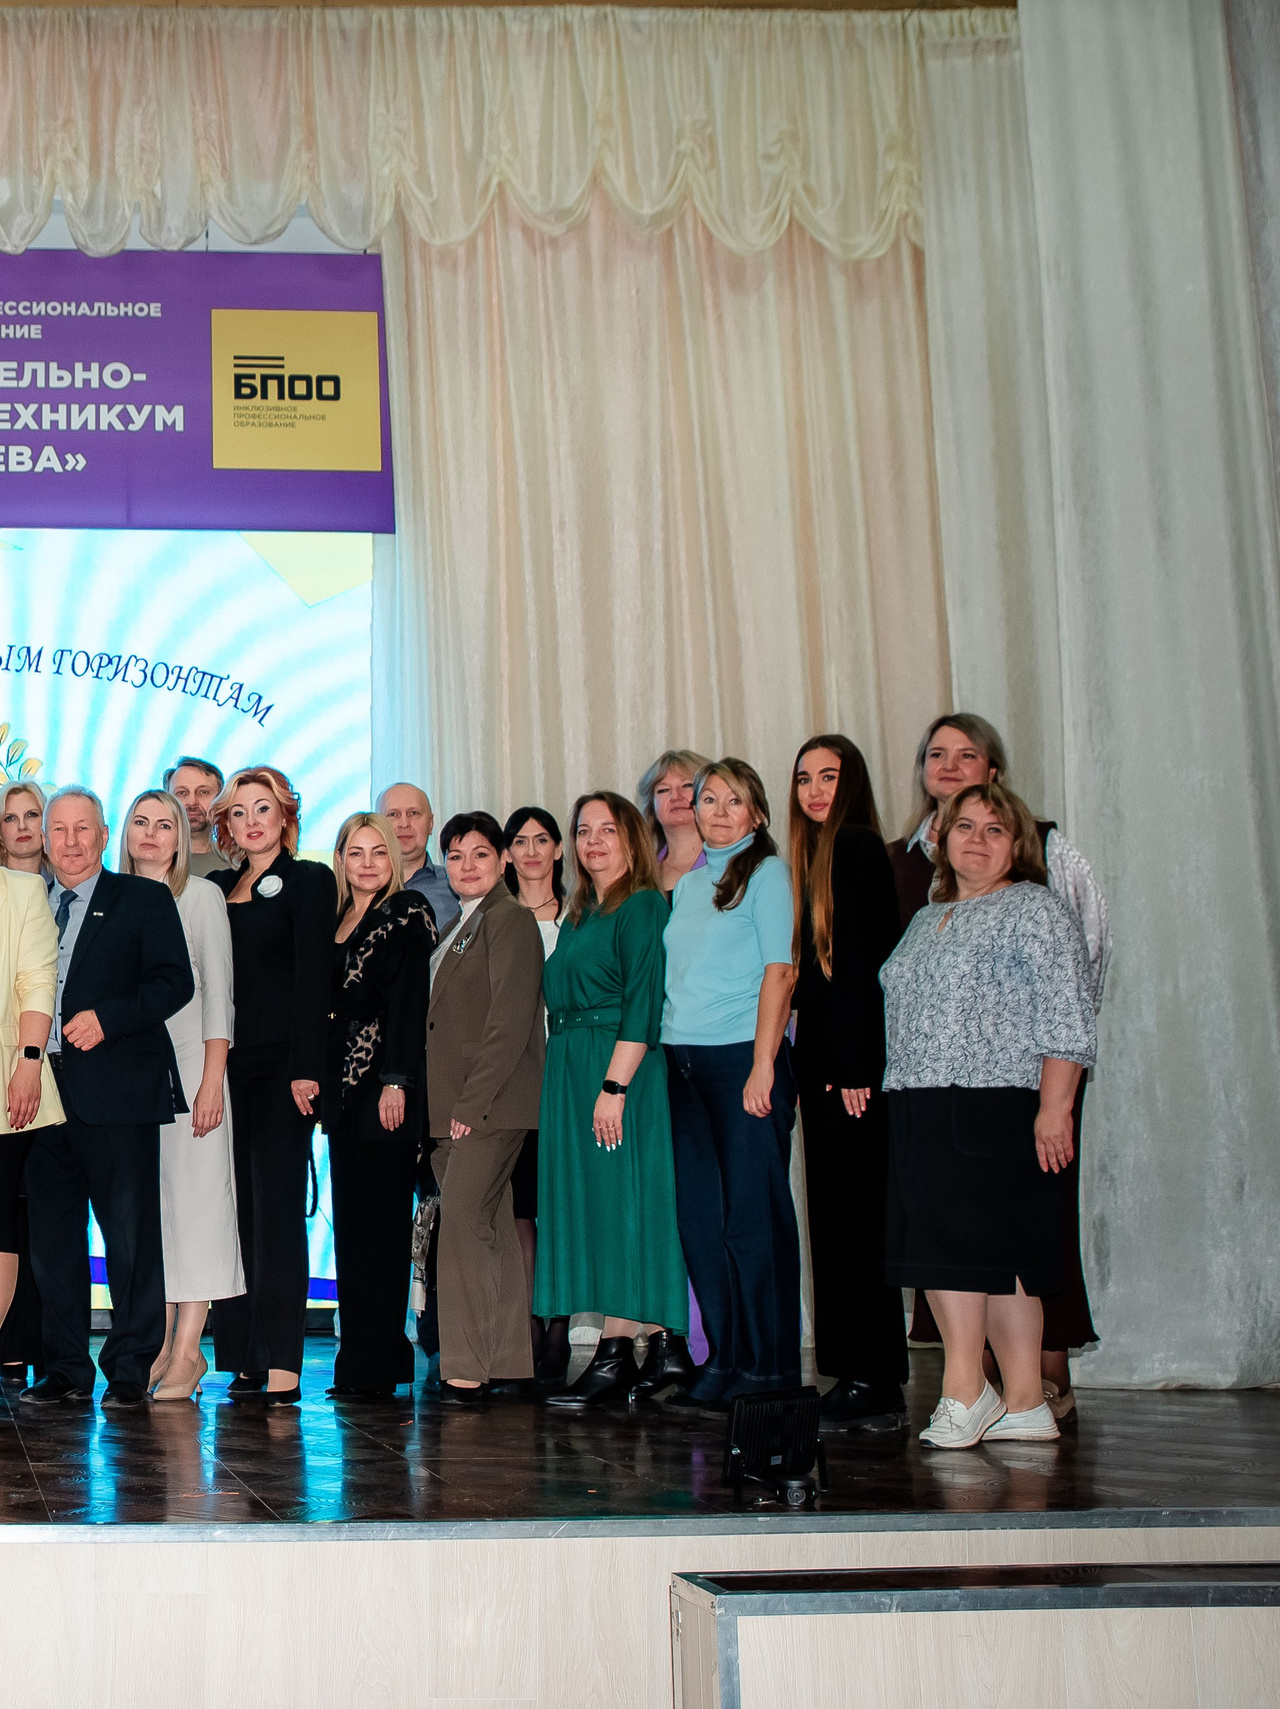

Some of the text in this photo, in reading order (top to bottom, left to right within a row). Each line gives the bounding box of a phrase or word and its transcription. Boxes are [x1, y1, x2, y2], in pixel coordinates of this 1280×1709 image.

[233, 373, 341, 401] БПОО
[233, 412, 327, 421] ПРОФЕССИОНАЛЬНОЕ
[52, 648, 275, 728] ГОРИЗОНТАМ
